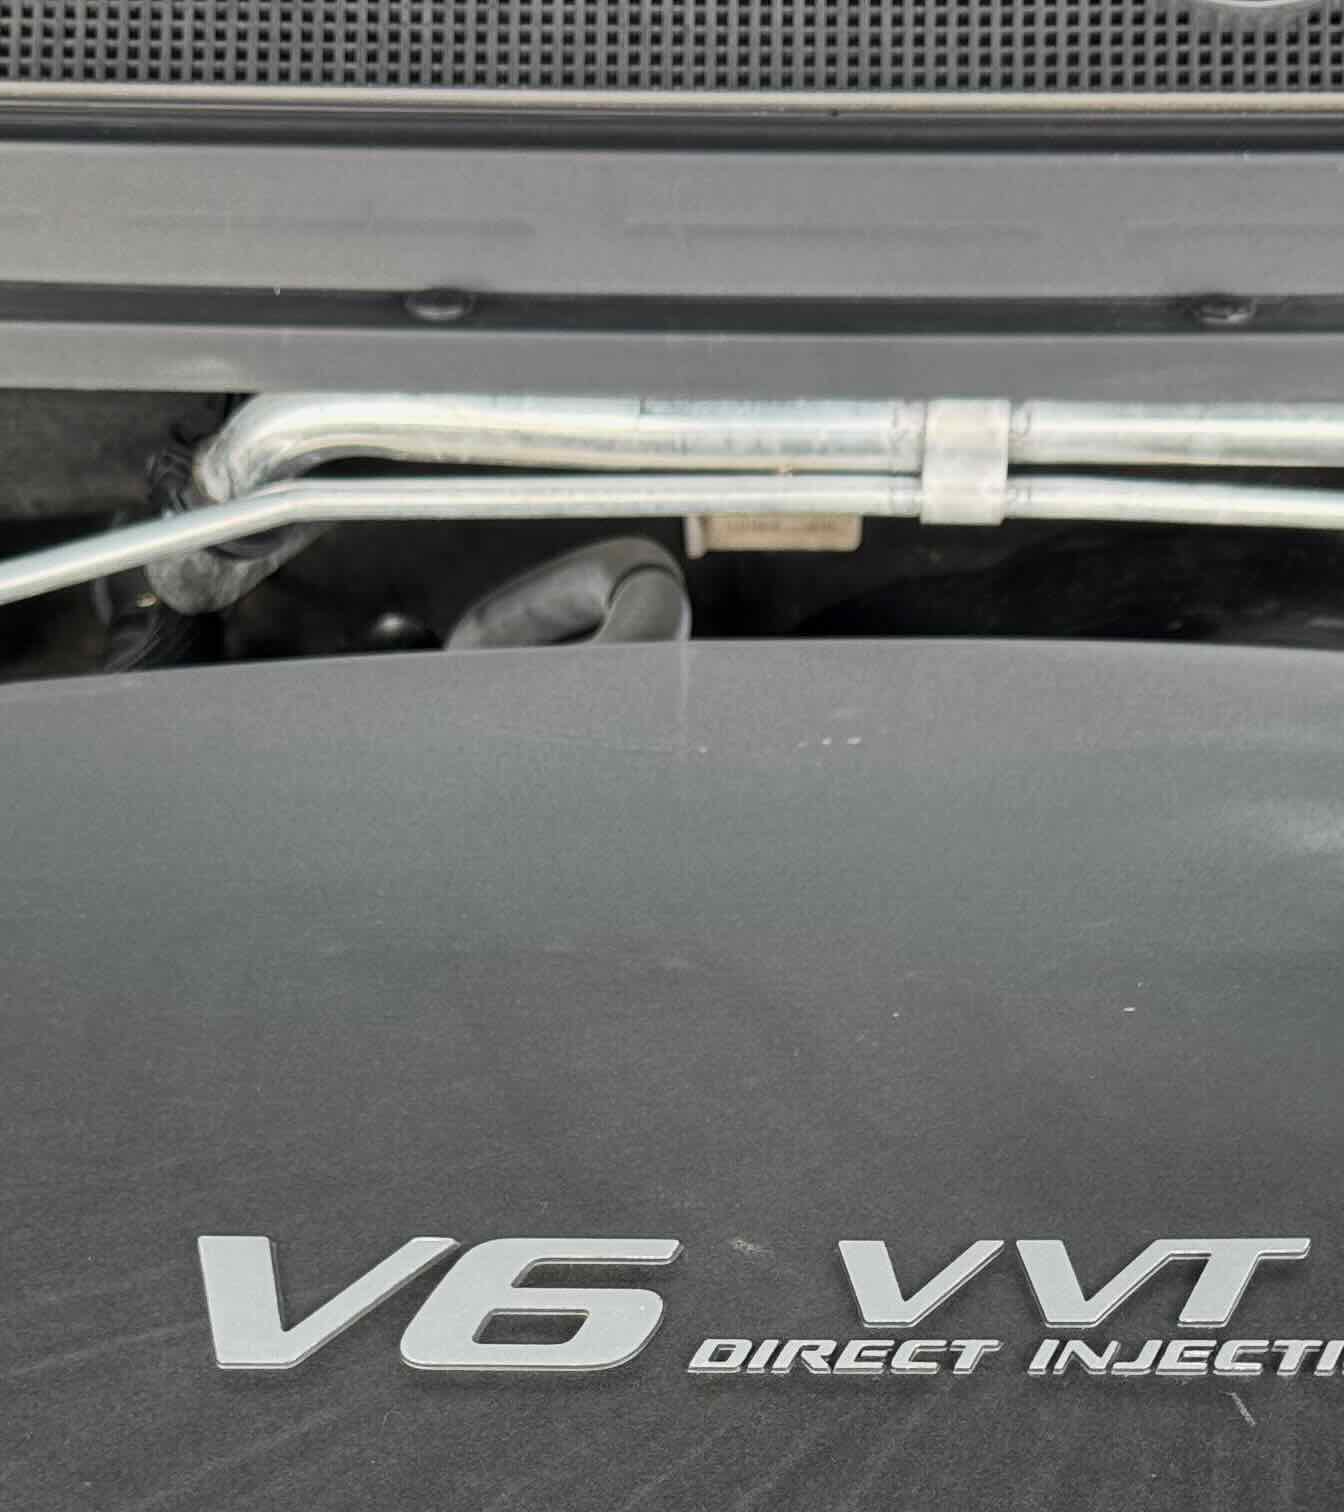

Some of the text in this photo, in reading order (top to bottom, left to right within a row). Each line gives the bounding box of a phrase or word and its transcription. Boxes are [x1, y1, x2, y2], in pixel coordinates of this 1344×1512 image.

[197, 1235, 1311, 1371] V6 VVT
[687, 1338, 1003, 1375] DIRECT
